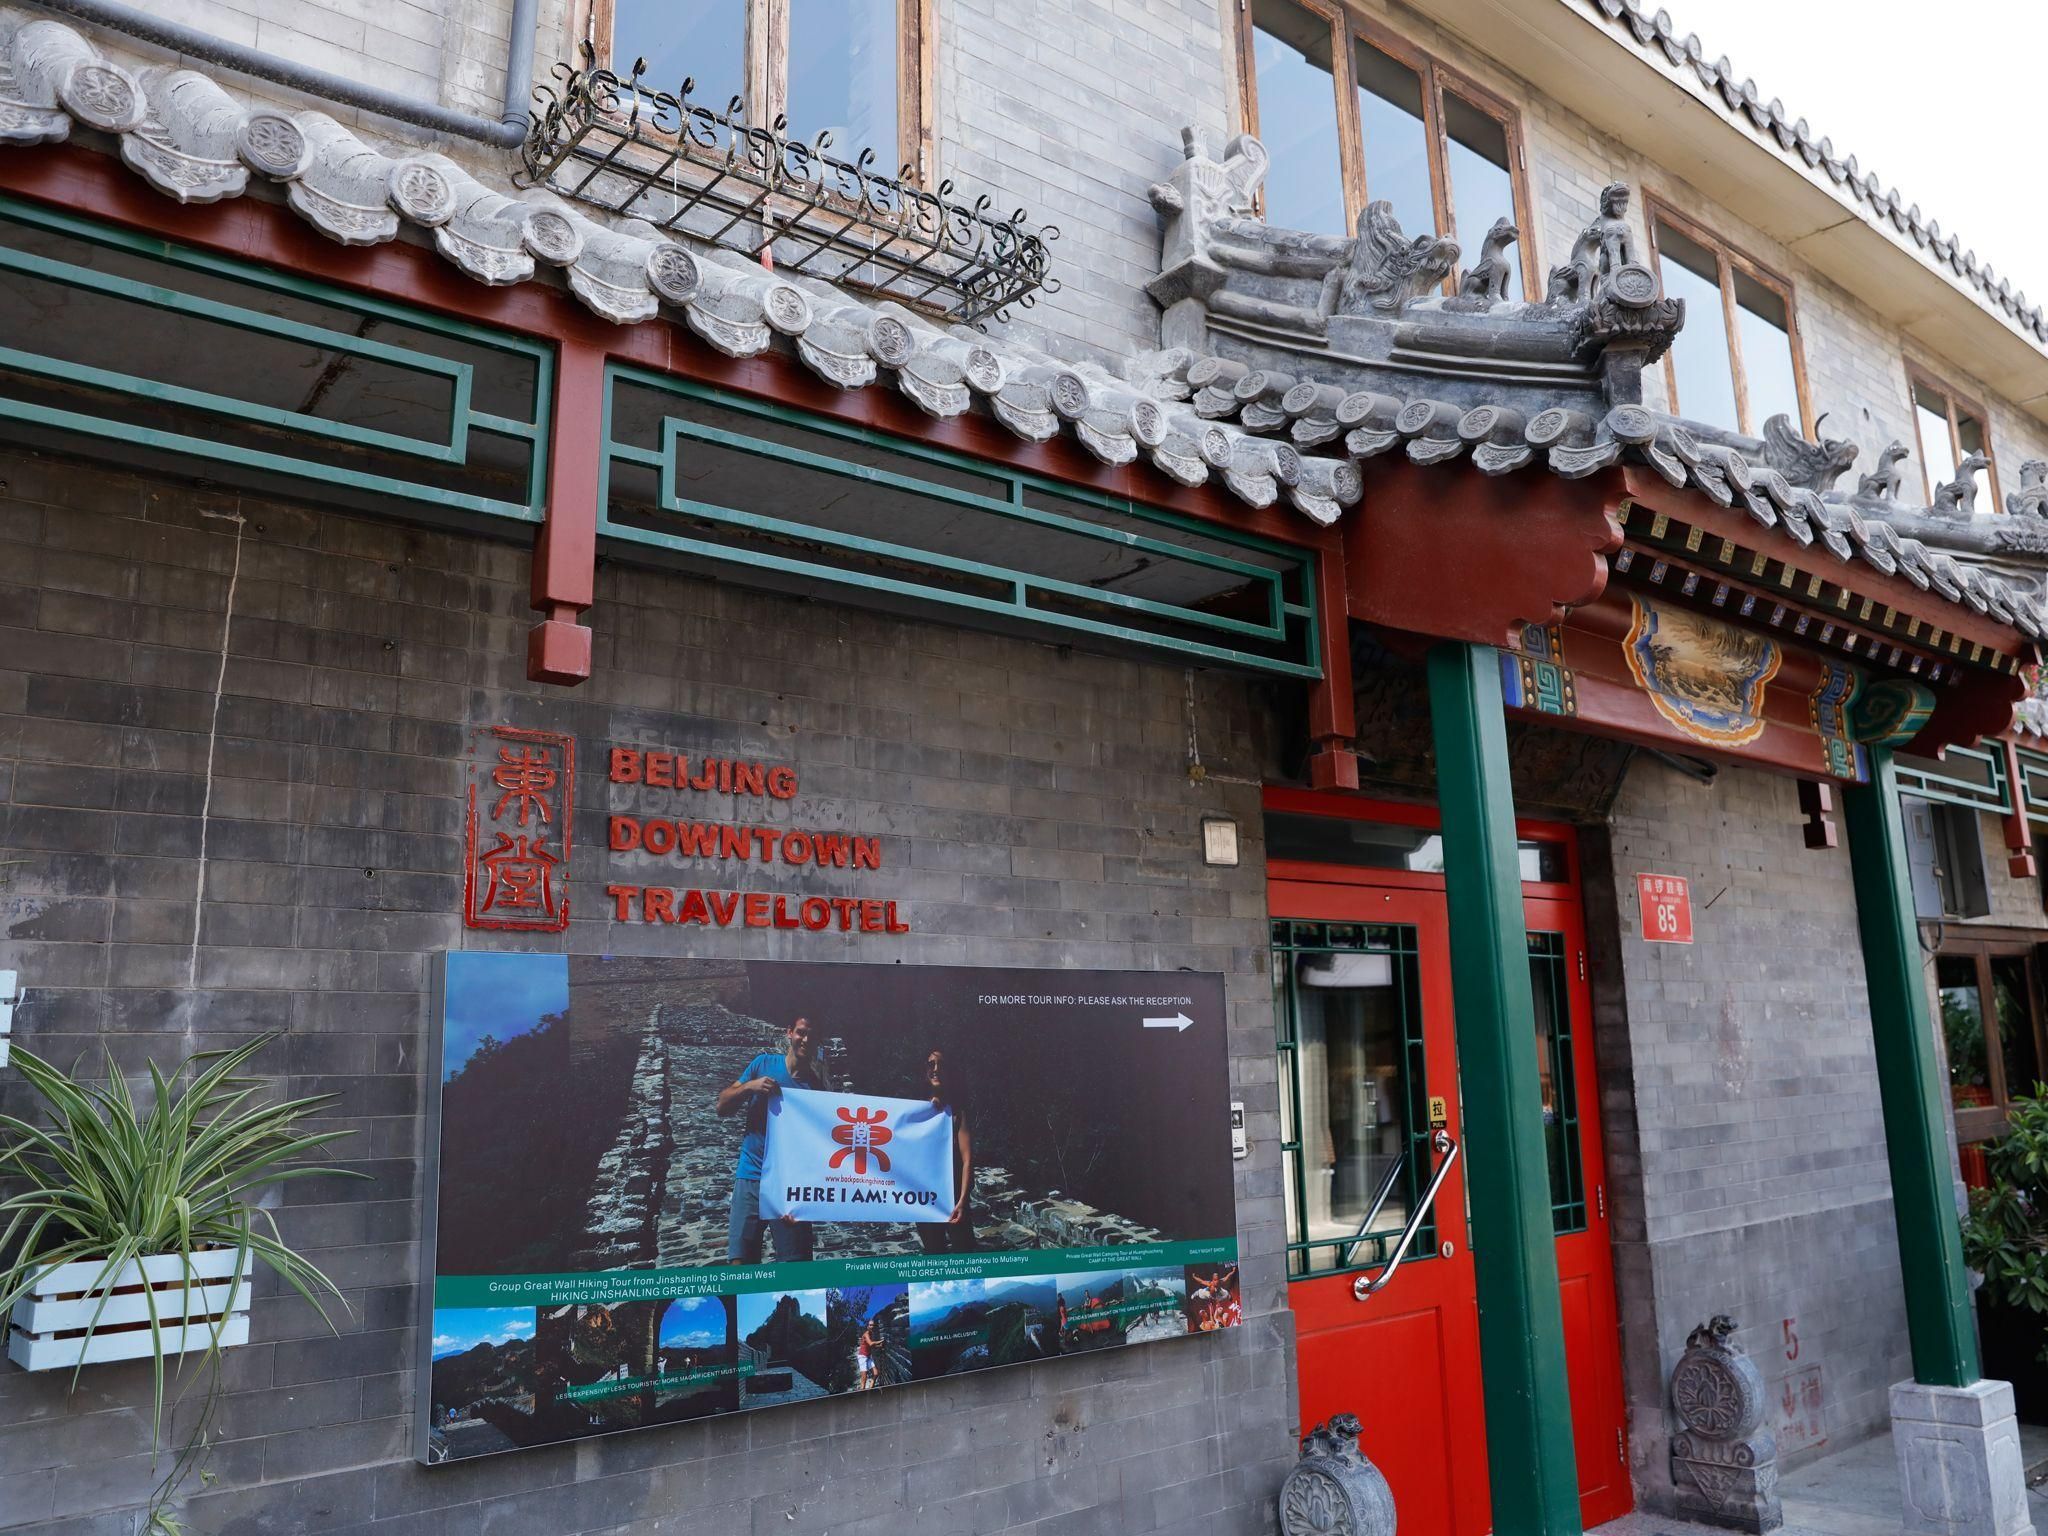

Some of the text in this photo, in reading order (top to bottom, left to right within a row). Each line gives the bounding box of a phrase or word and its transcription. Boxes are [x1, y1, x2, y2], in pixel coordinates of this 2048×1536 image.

[609, 747, 798, 799] BEIJING
[609, 815, 881, 870] DOWNTOWN
[607, 885, 909, 933] TRAVELOTEL
[1657, 903, 1677, 933] 85
[978, 995, 998, 1005] FOR
[1000, 995, 1026, 1005] MORE
[1028, 995, 1052, 1005] TOUR
[1078, 995, 1110, 1005] PLEASE
[1111, 996, 1128, 1005] ASK
[1128, 996, 1145, 1006] THE
[1432, 1101, 1443, 1117] 拉
[787, 1186, 938, 1206] HERE I AM! YOU?
[845, 1263, 871, 1271] Private
[872, 1261, 888, 1269] Wild
[889, 1260, 910, 1269] Great
[910, 1259, 926, 1268] Wall
[927, 1258, 949, 1268] Hiking
[949, 1258, 965, 1266] from
[966, 1257, 991, 1265] Jiankou
[999, 1255, 1029, 1264] Mutianyu
[897, 1266, 982, 1278] WILD GREAT WALLKING
[489, 1270, 776, 1292] Group Great Wall Hiking Tour from Jinshanling to Simatai West
[551, 1284, 723, 1301] HIKING JINSHANLING GREAT WALL
[1782, 1318, 1799, 1361] 5
[555, 1392, 572, 1400] LESS
[610, 1384, 627, 1392] LESS
[662, 1376, 679, 1384] MORE
